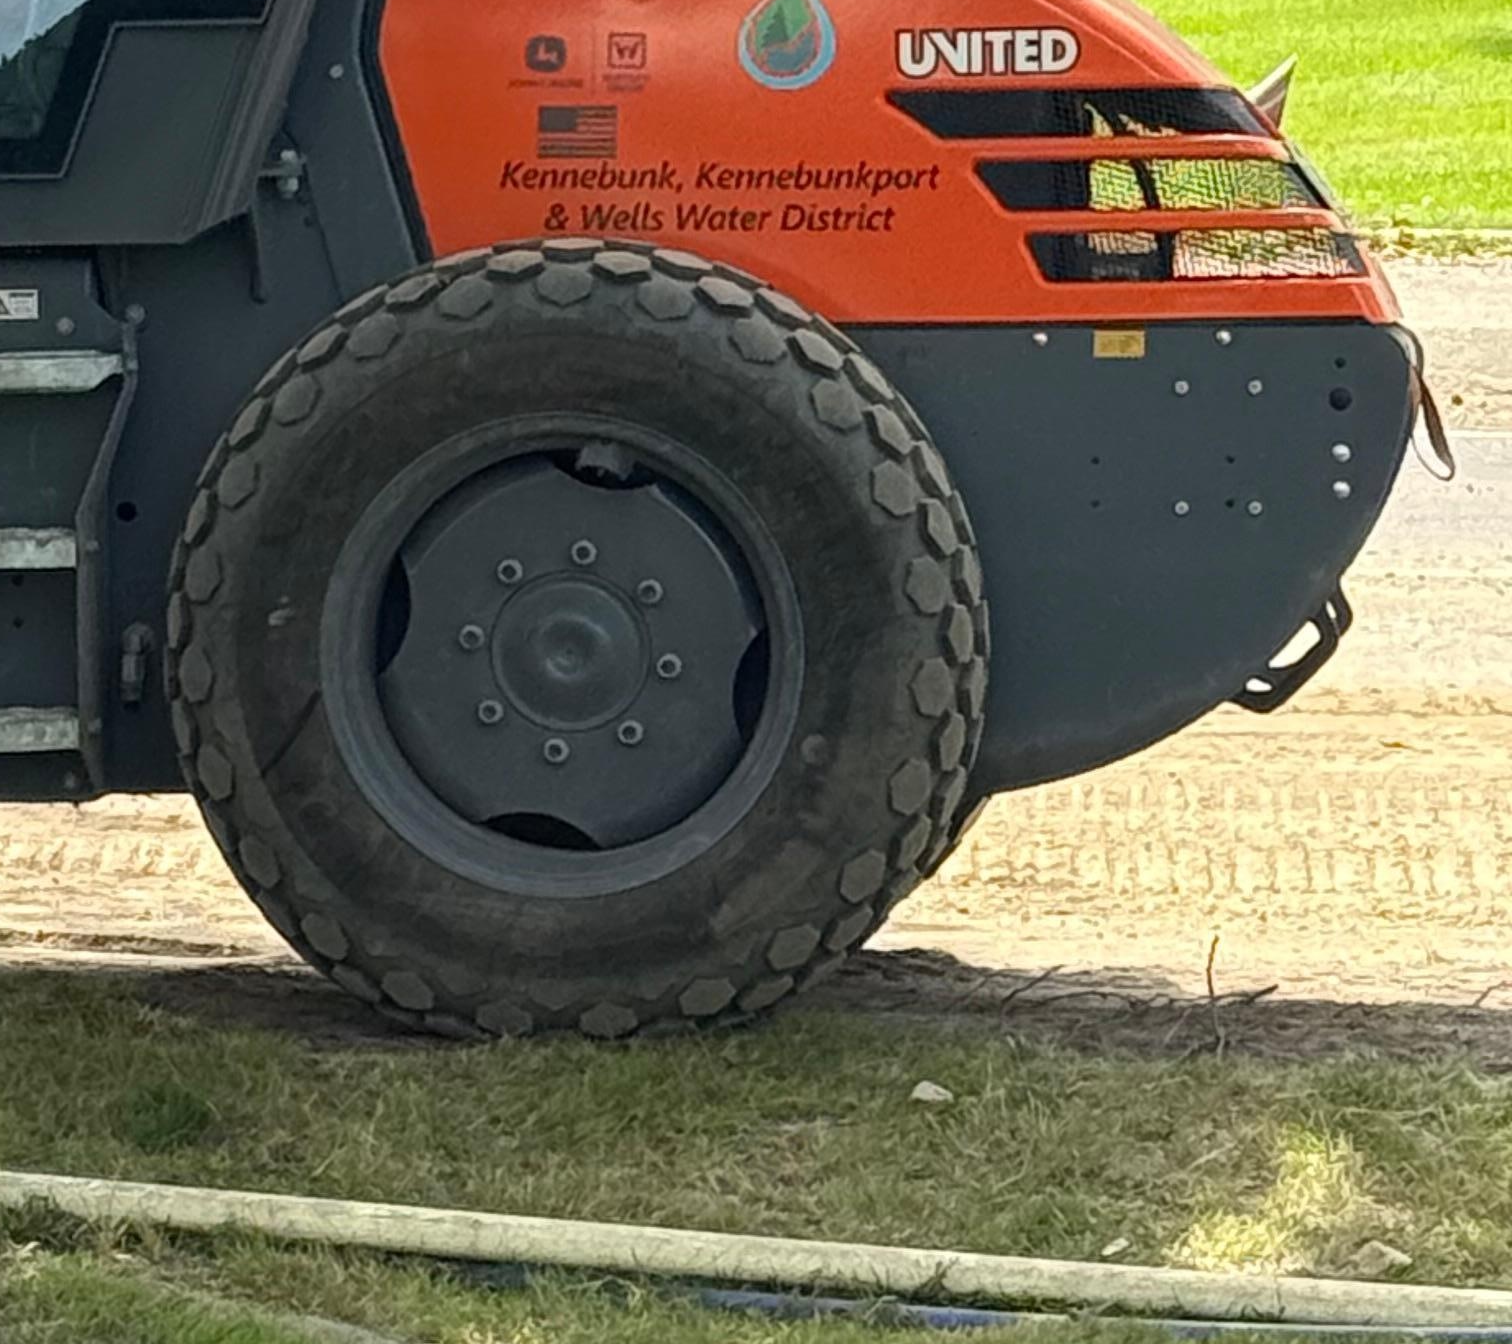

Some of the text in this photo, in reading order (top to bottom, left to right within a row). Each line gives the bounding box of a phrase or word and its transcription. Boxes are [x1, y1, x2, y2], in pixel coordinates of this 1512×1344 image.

[896, 27, 1080, 78] UNITED
[498, 160, 940, 197] Kennebunk, Kennebunkport
[544, 202, 896, 232] & Wells Water District
